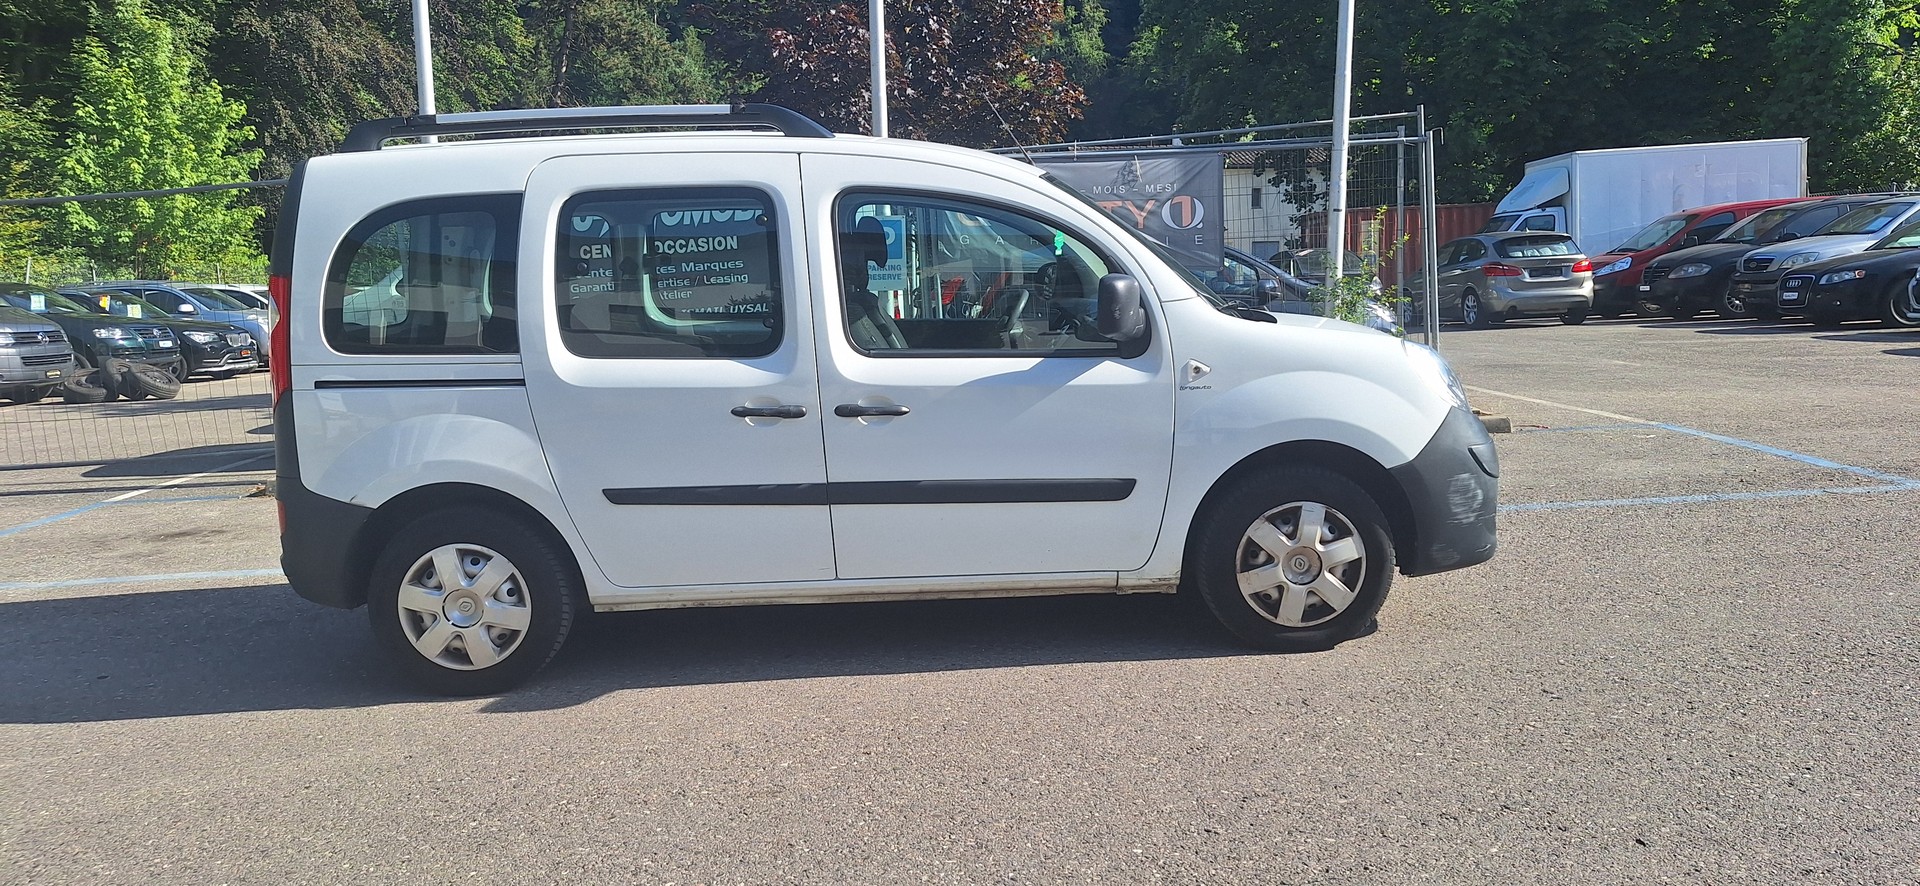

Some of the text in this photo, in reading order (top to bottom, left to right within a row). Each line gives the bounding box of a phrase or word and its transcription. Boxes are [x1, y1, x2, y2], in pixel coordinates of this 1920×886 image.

[1093, 185, 1126, 194] MOIS
[1145, 183, 1177, 192] MESI
[654, 235, 738, 255] OCCASION
[681, 260, 744, 272] Marques
[703, 273, 749, 285] Leasing
[729, 303, 769, 314] UYSAL
